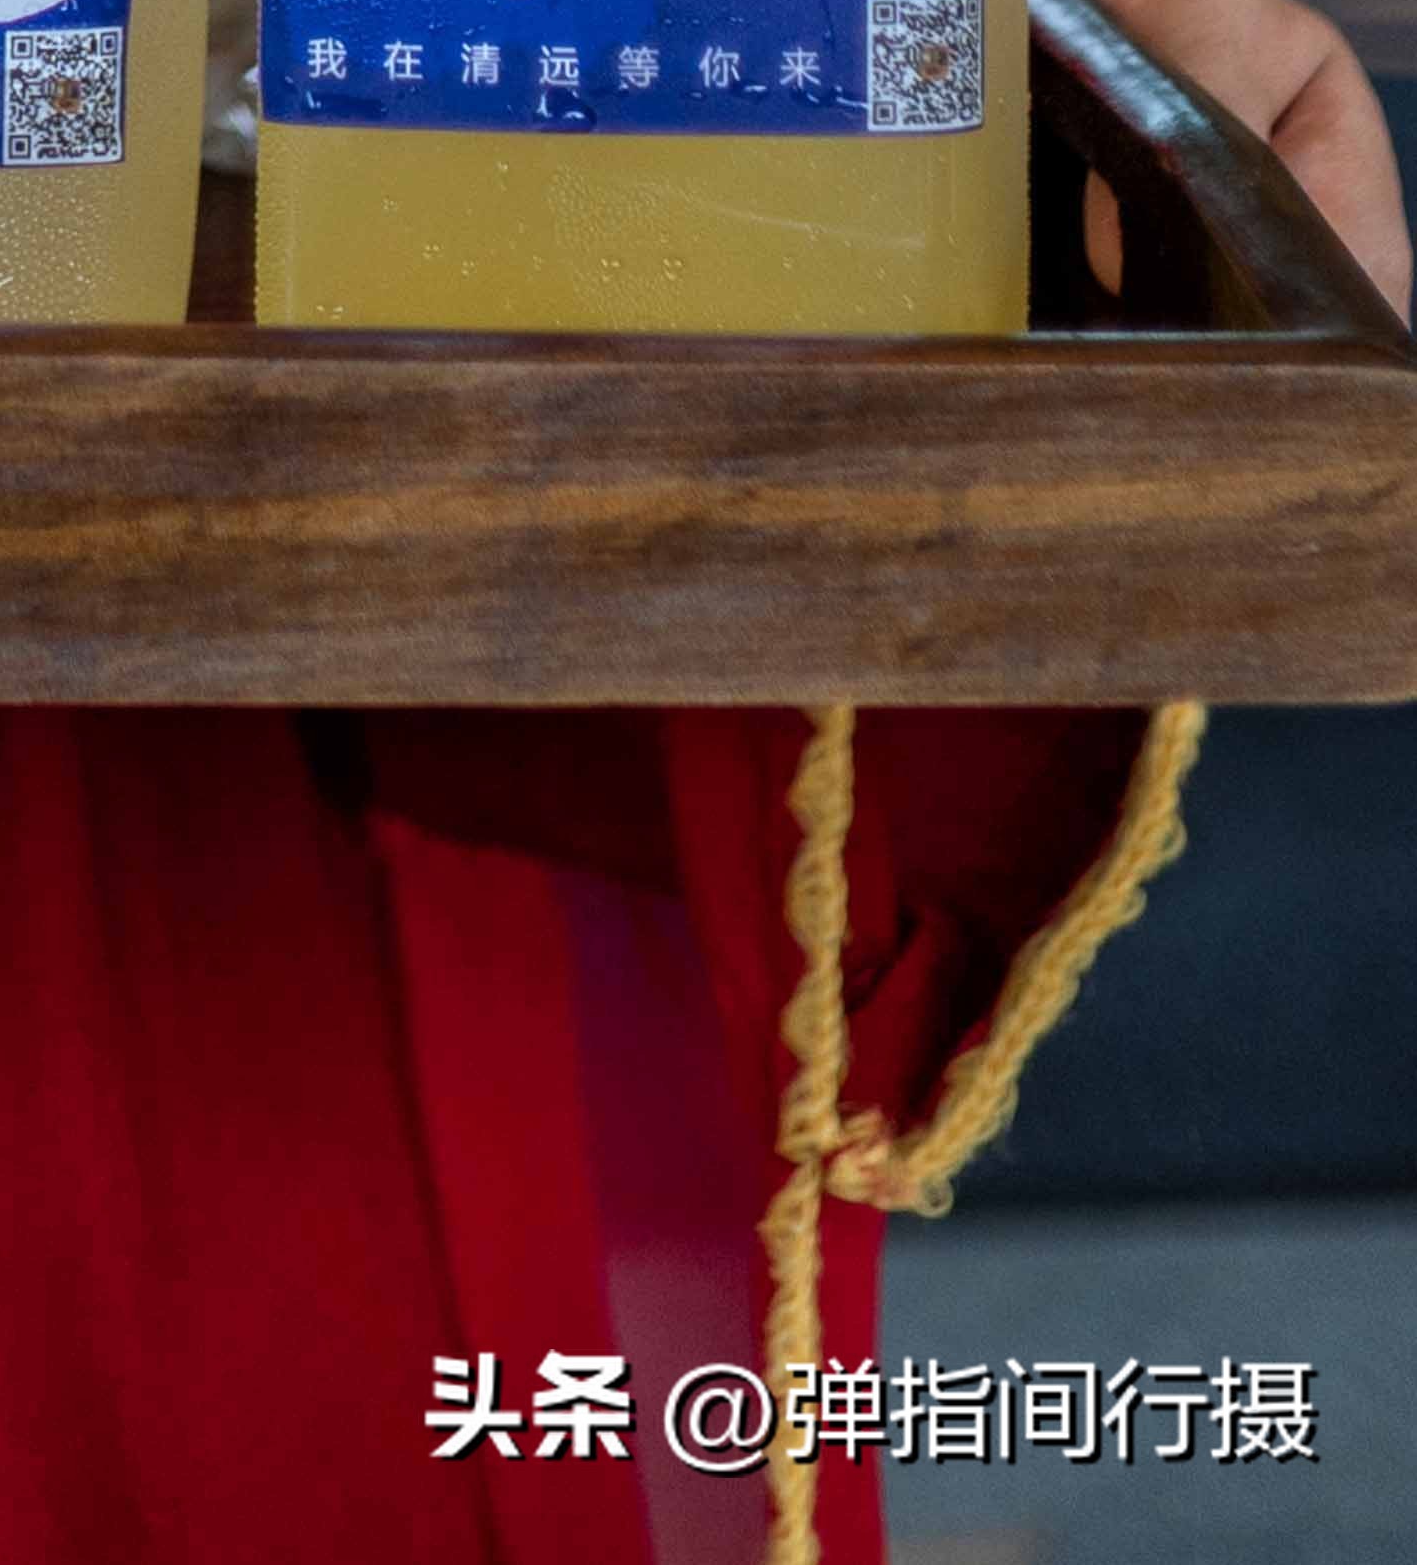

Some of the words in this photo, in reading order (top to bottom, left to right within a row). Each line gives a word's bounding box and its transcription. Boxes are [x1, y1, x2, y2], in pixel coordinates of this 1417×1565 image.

[307, 37, 821, 89] 我在清远等你来
